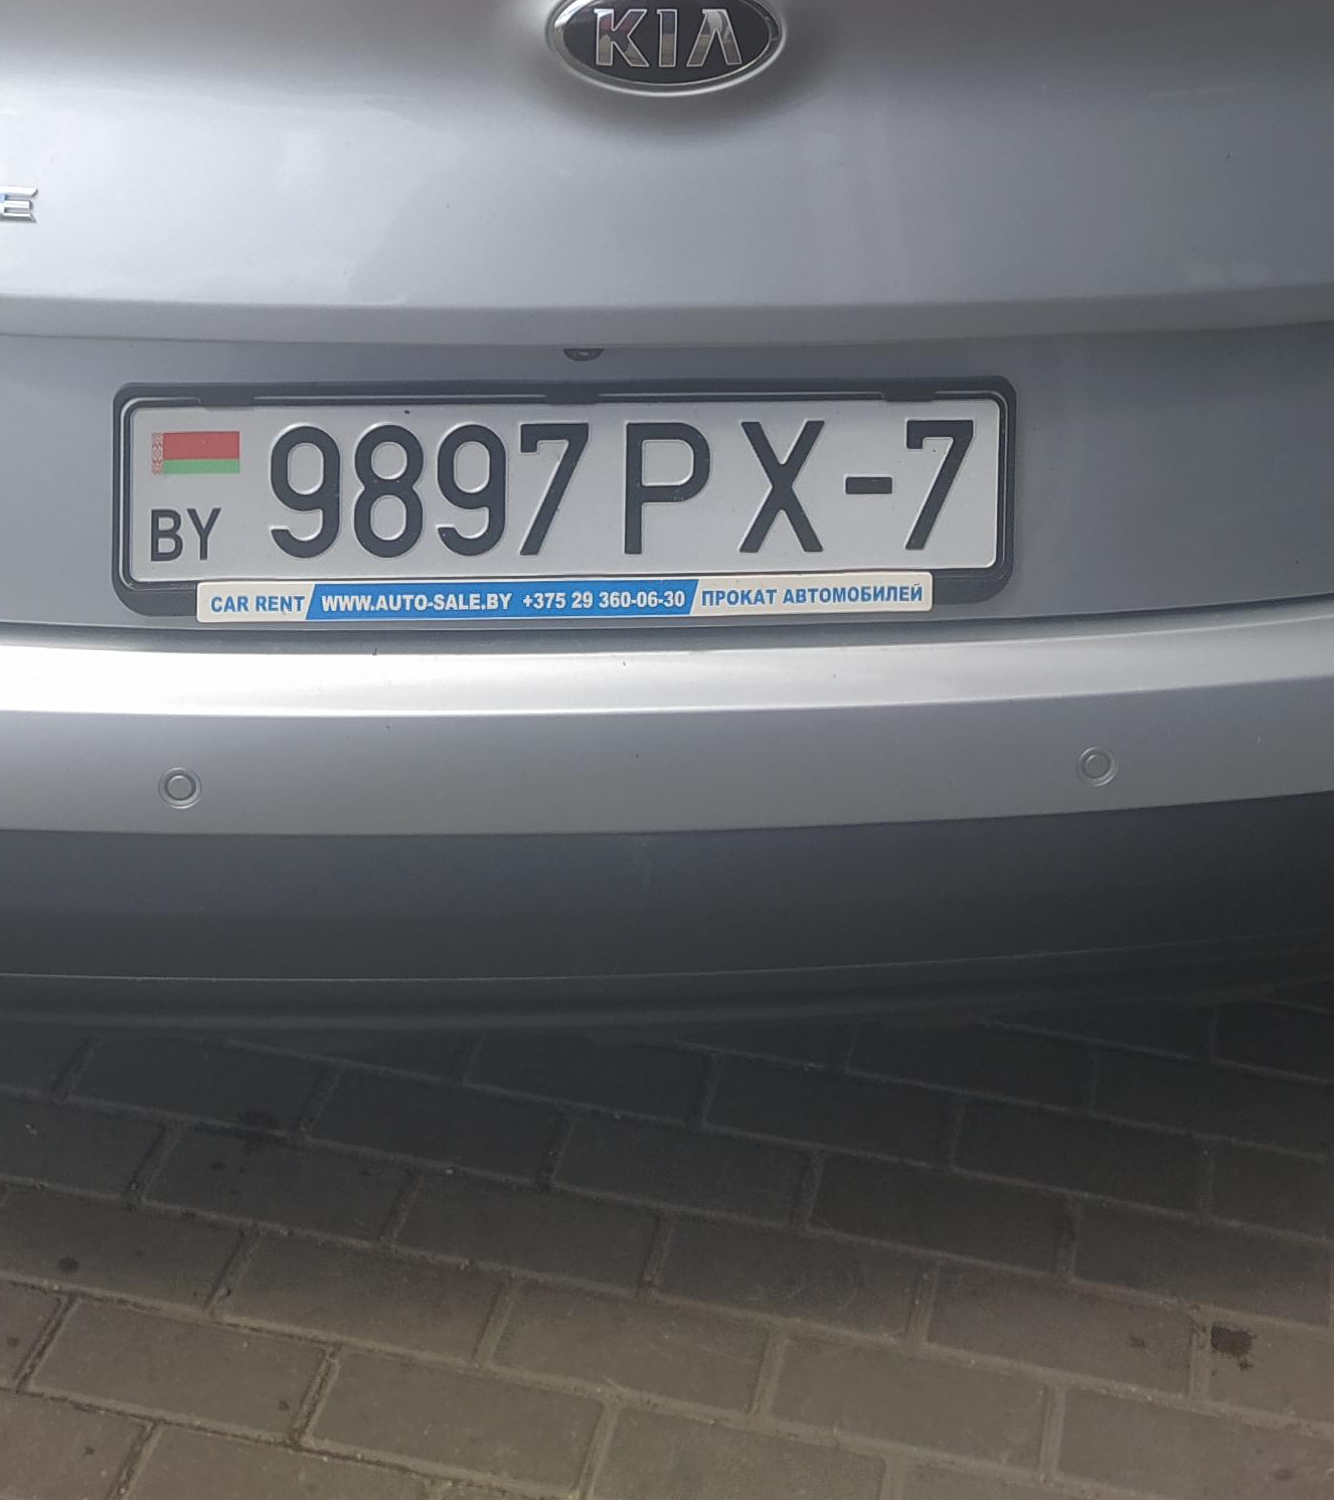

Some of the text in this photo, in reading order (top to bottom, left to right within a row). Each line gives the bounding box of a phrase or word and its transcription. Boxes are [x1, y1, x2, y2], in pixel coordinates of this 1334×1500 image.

[593, 7, 744, 68] KIA
[149, 508, 222, 562] BY
[210, 595, 306, 613] CAR RENT
[320, 589, 686, 613] WWW.AUTO-SALE.BY +375 29 360-06-30
[701, 583, 923, 607] ПРОКАТ АВТОМОБИЛЕЙ
